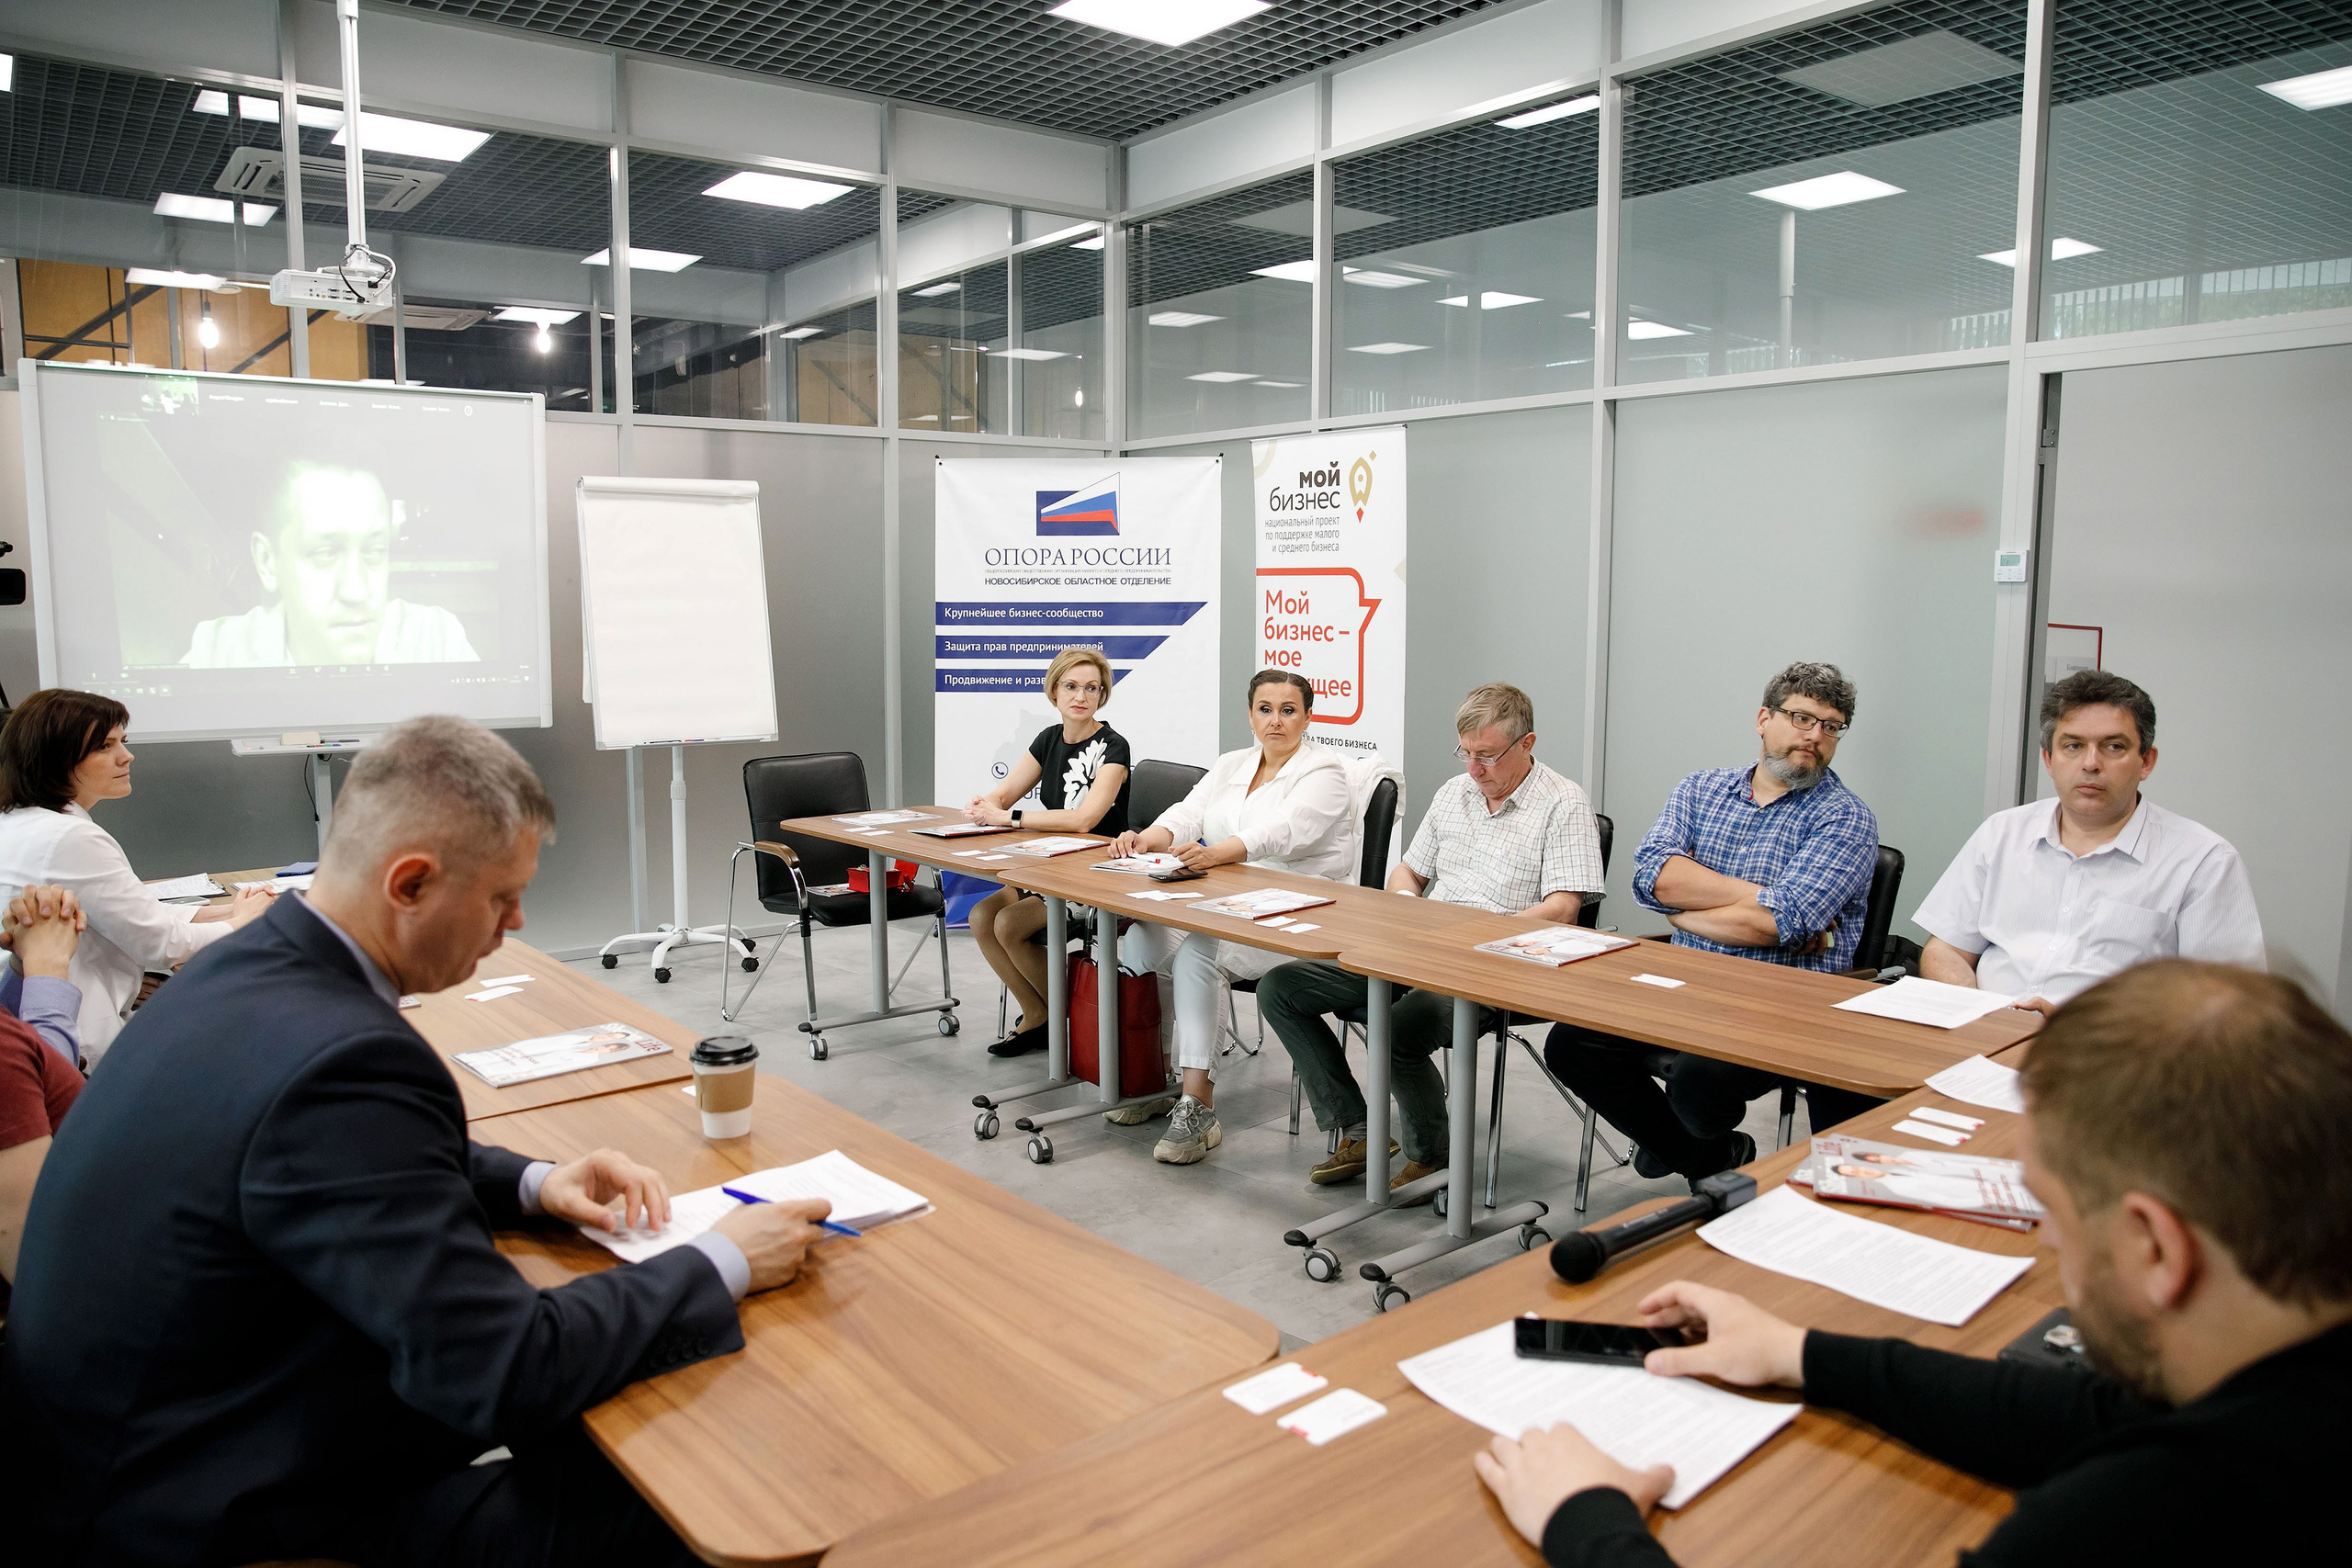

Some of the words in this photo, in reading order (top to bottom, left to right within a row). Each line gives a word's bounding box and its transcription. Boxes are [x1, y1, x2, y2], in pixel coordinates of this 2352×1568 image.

[1299, 461, 1340, 489] мой
[1269, 486, 1340, 512] бизнес
[1264, 516, 1314, 529] национальный
[1315, 516, 1340, 528] проект
[1265, 531, 1273, 540] по
[1274, 530, 1313, 542] поддержке
[1314, 528, 1340, 539] малого
[1272, 544, 1277, 553] и
[1278, 543, 1310, 555] среднего
[1311, 541, 1340, 553] бизнеса
[984, 547, 1068, 566] ОПОРА
[1070, 547, 1171, 566] РОССИИ
[984, 577, 1061, 586] НОВОСИБИРСКОЕ
[1064, 577, 1118, 586] ОБЛАСТНОЕ
[1120, 577, 1171, 587] ОТДЕЛЕНИЕ
[1265, 590, 1309, 615] Мой
[944, 607, 1006, 619] Крупнейшее
[1009, 608, 1104, 619] бизнес-сообщество
[944, 641, 981, 652] Защита
[983, 643, 1007, 653] прав
[1264, 649, 1303, 667] мое
[944, 675, 1013, 687] Продвижение
[1015, 677, 1023, 685] и
[1317, 736, 1343, 747] ТВОЕГО
[1344, 739, 1378, 750] БИЗНЕСА
